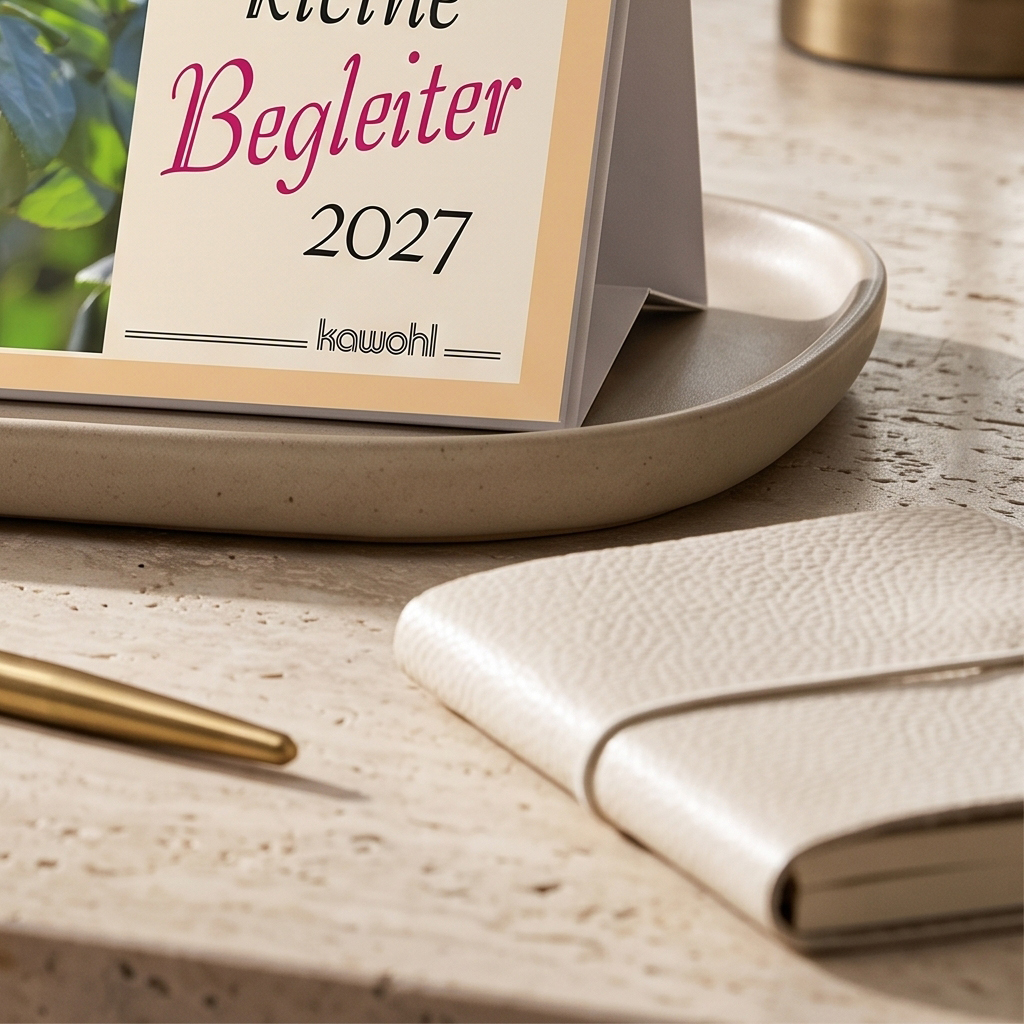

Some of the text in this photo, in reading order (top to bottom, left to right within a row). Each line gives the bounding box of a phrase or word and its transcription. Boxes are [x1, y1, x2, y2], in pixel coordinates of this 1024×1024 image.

[160, 50, 523, 196] Begleiter
[302, 202, 474, 275] 2027
[316, 317, 439, 358] kawohl
